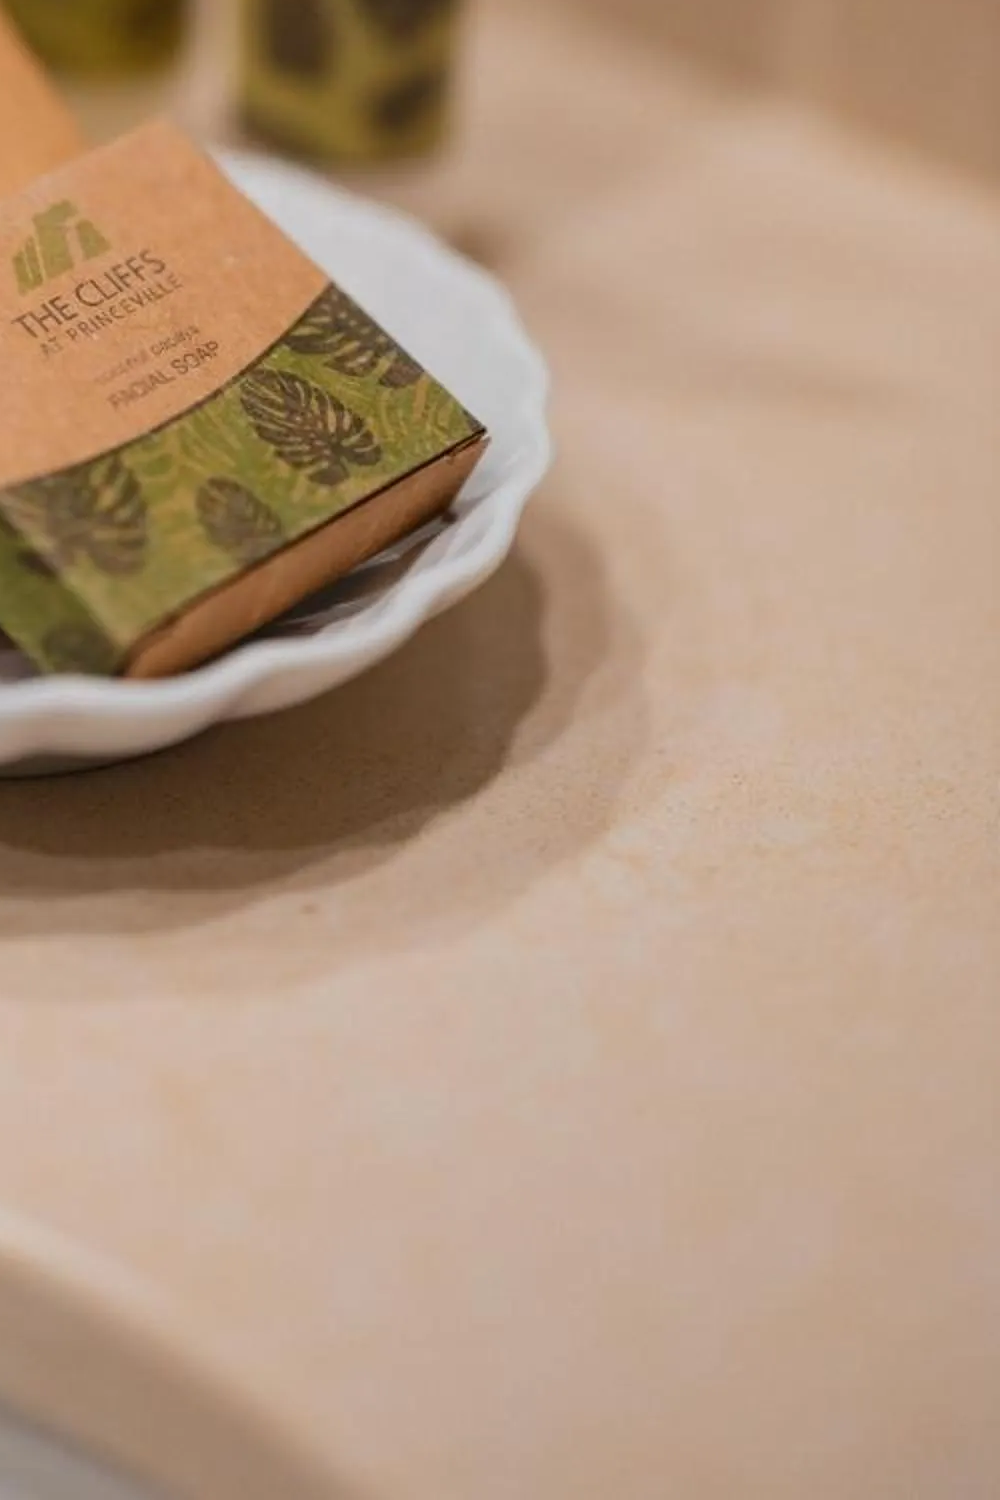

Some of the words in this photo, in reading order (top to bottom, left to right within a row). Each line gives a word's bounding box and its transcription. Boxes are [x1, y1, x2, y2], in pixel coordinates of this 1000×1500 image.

[11, 296, 78, 338] THE
[75, 249, 166, 307] CLIFFS
[40, 336, 64, 357] AT
[65, 273, 184, 341] PRINCEVILLE
[107, 369, 176, 411] FACIAL
[170, 340, 219, 376] SOAP
